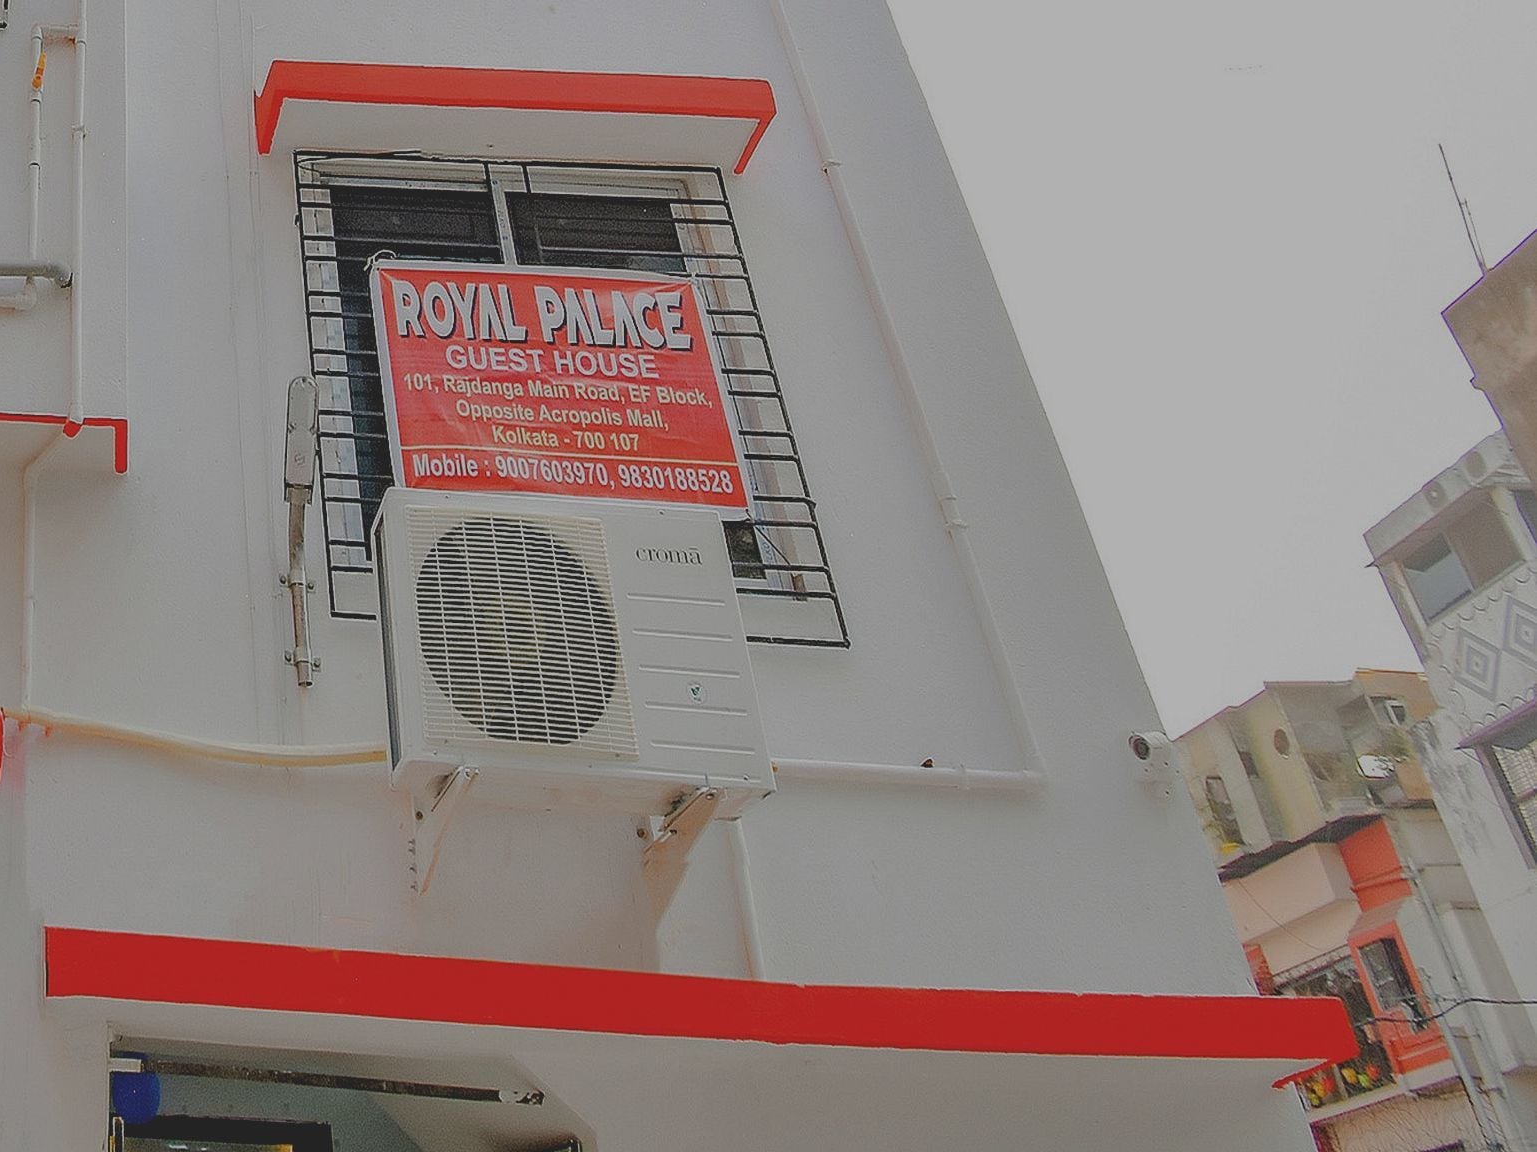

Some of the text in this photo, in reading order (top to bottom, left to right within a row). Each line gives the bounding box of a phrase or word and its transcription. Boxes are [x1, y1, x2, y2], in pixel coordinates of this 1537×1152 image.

[391, 280, 692, 350] ROYAL PALACE
[445, 344, 660, 379] GUEST HOUSE
[403, 373, 713, 409] 101, Rajdanga Main Road, EF Block,
[456, 399, 669, 431] Opposite Acropolis Mall,
[492, 425, 559, 447] Kolkata
[572, 431, 605, 450] 700
[609, 433, 639, 451] 107
[413, 453, 478, 477] Mobile
[495, 455, 615, 490] 9007603970,
[617, 464, 733, 494] 9830188528
